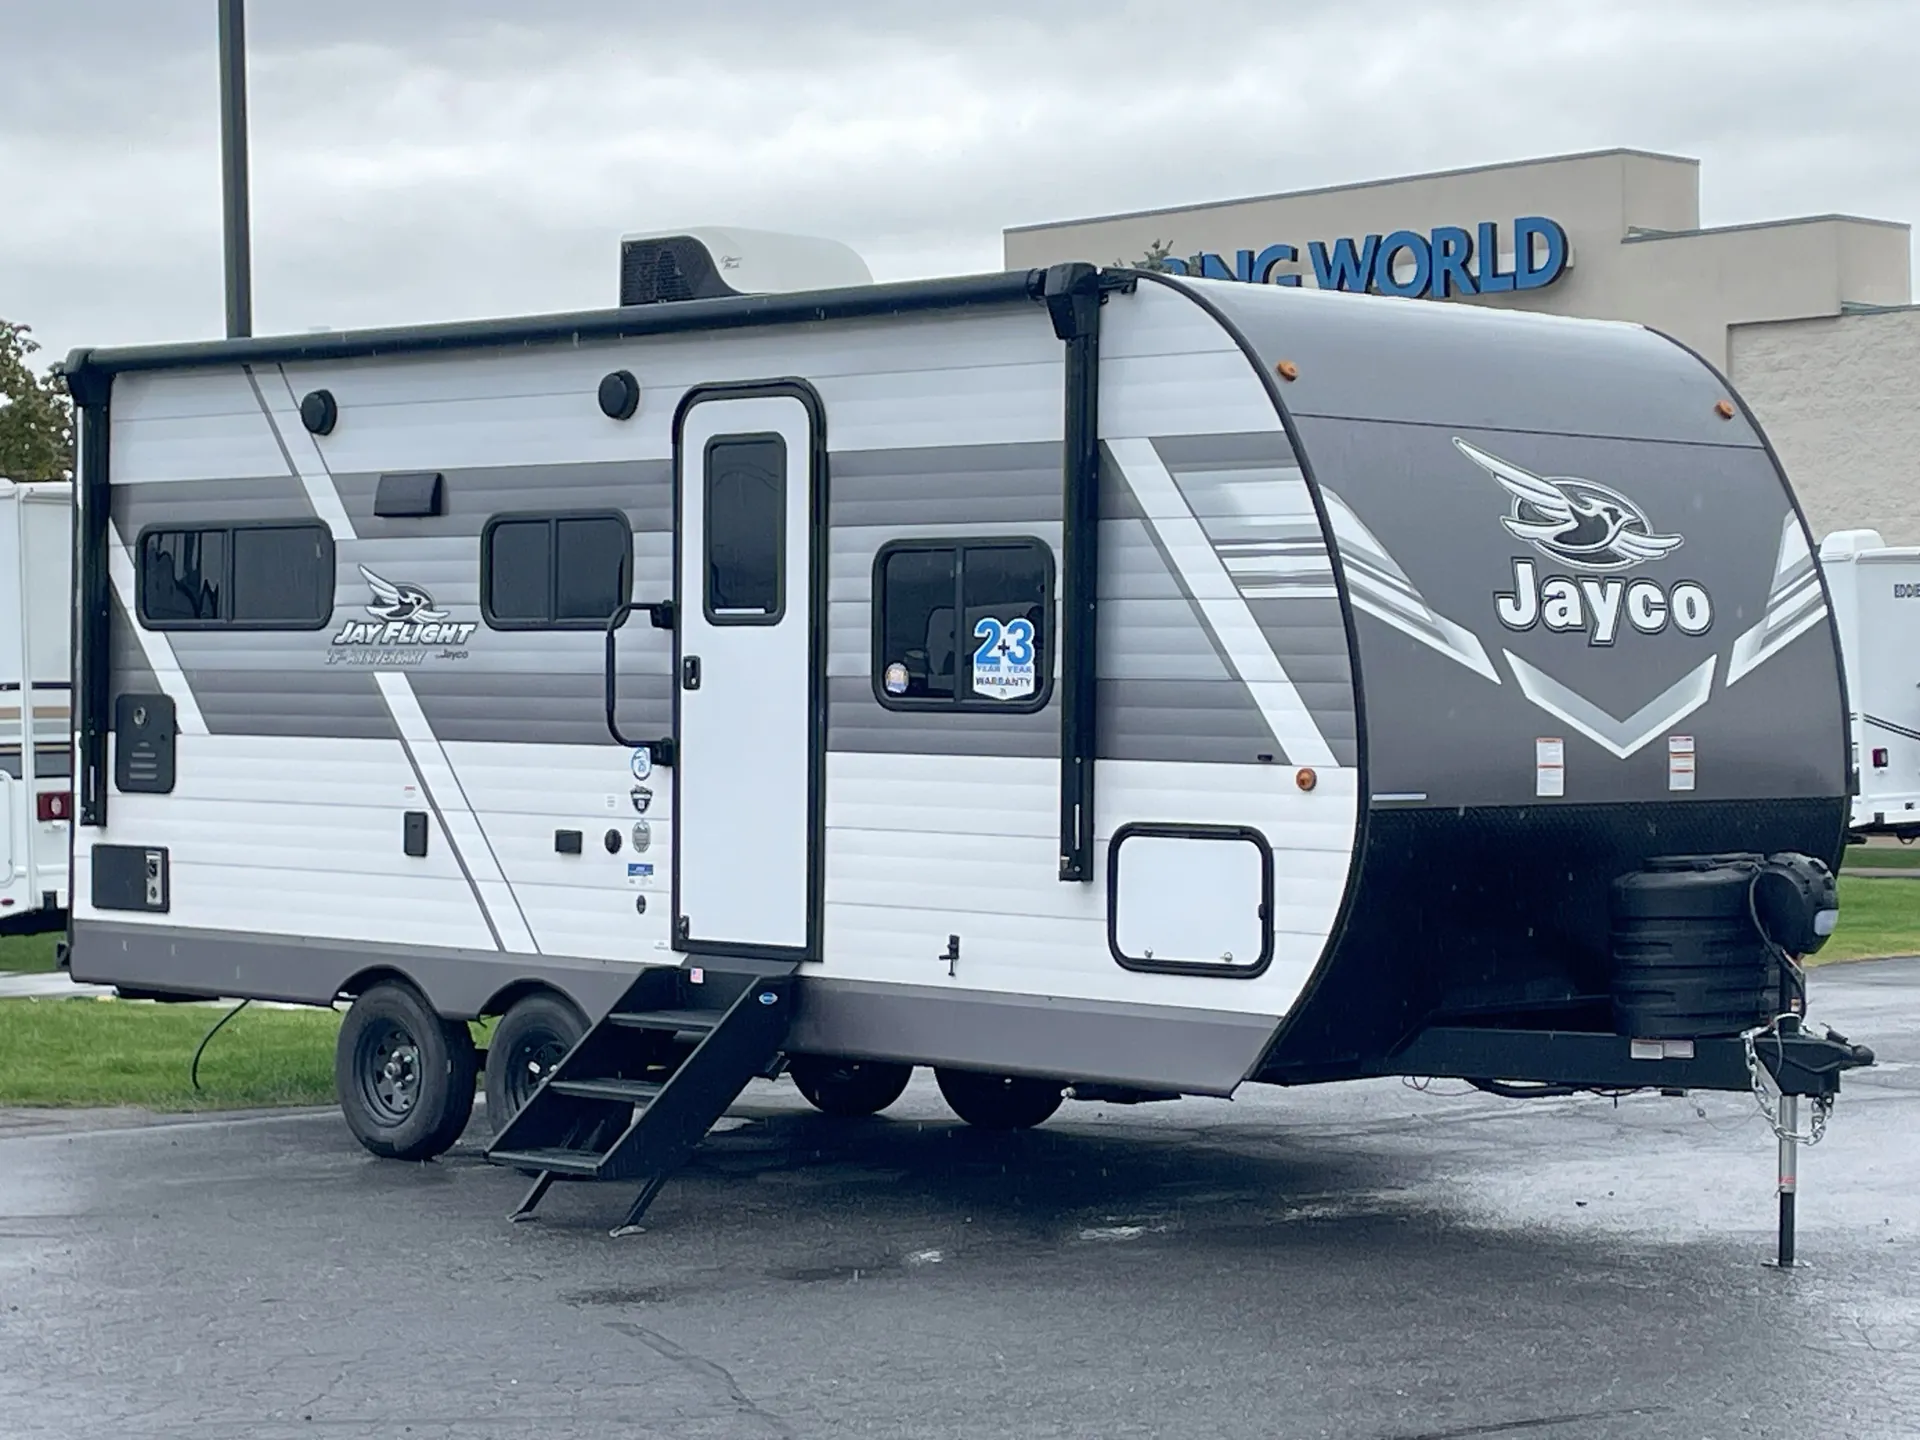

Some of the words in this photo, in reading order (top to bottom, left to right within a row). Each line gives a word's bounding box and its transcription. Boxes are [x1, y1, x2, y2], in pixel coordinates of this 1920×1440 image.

[1308, 216, 1568, 299] WORLD
[1493, 555, 1714, 647] Jayco
[976, 676, 1032, 687] WARRANTY
